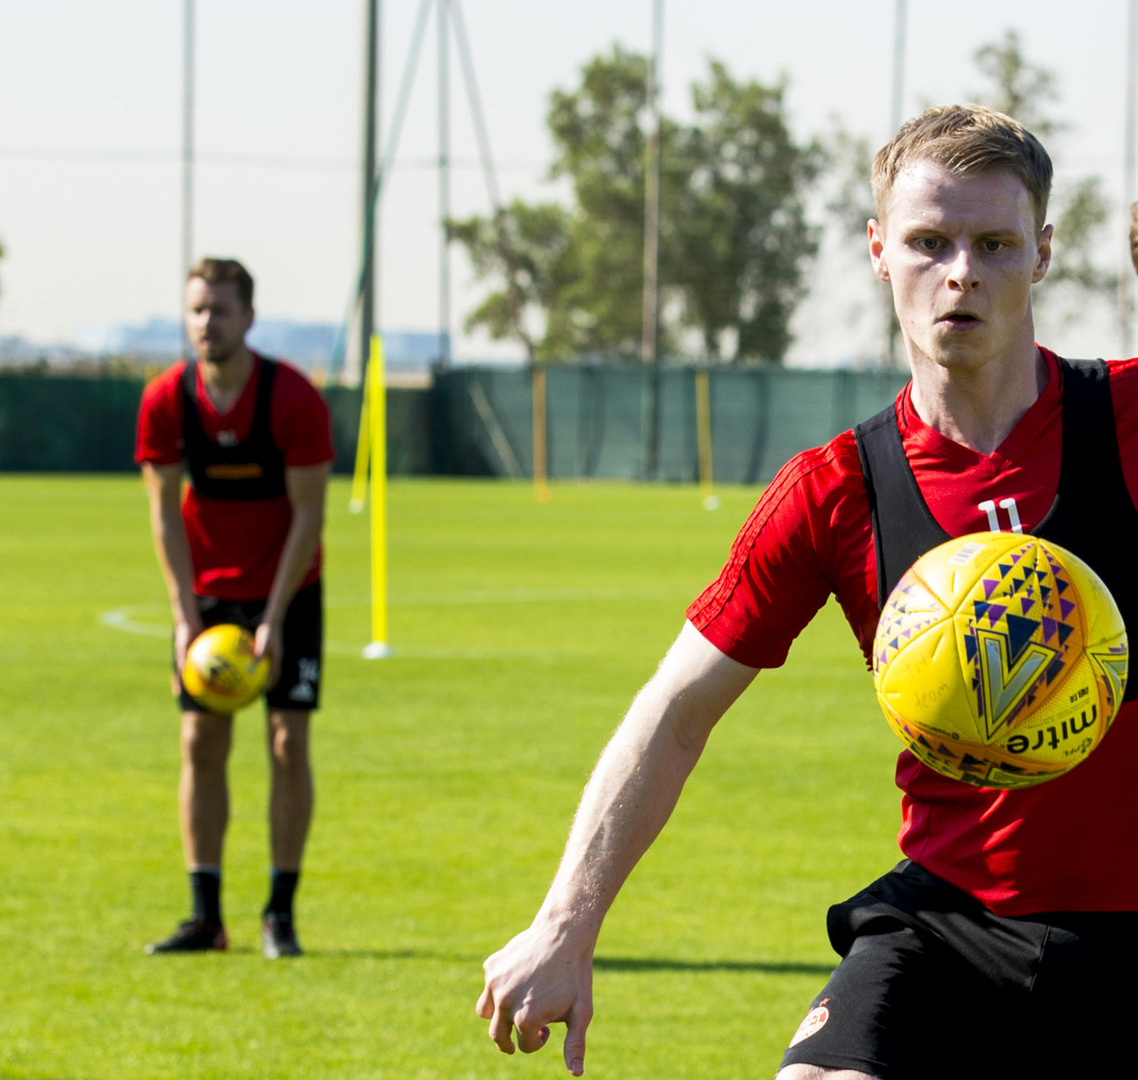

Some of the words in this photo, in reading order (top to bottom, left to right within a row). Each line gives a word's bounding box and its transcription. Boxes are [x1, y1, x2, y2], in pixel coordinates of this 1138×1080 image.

[978, 497, 1023, 534] 11
[1069, 686, 1090, 705] DELTA
[1007, 704, 1098, 754] mitre
